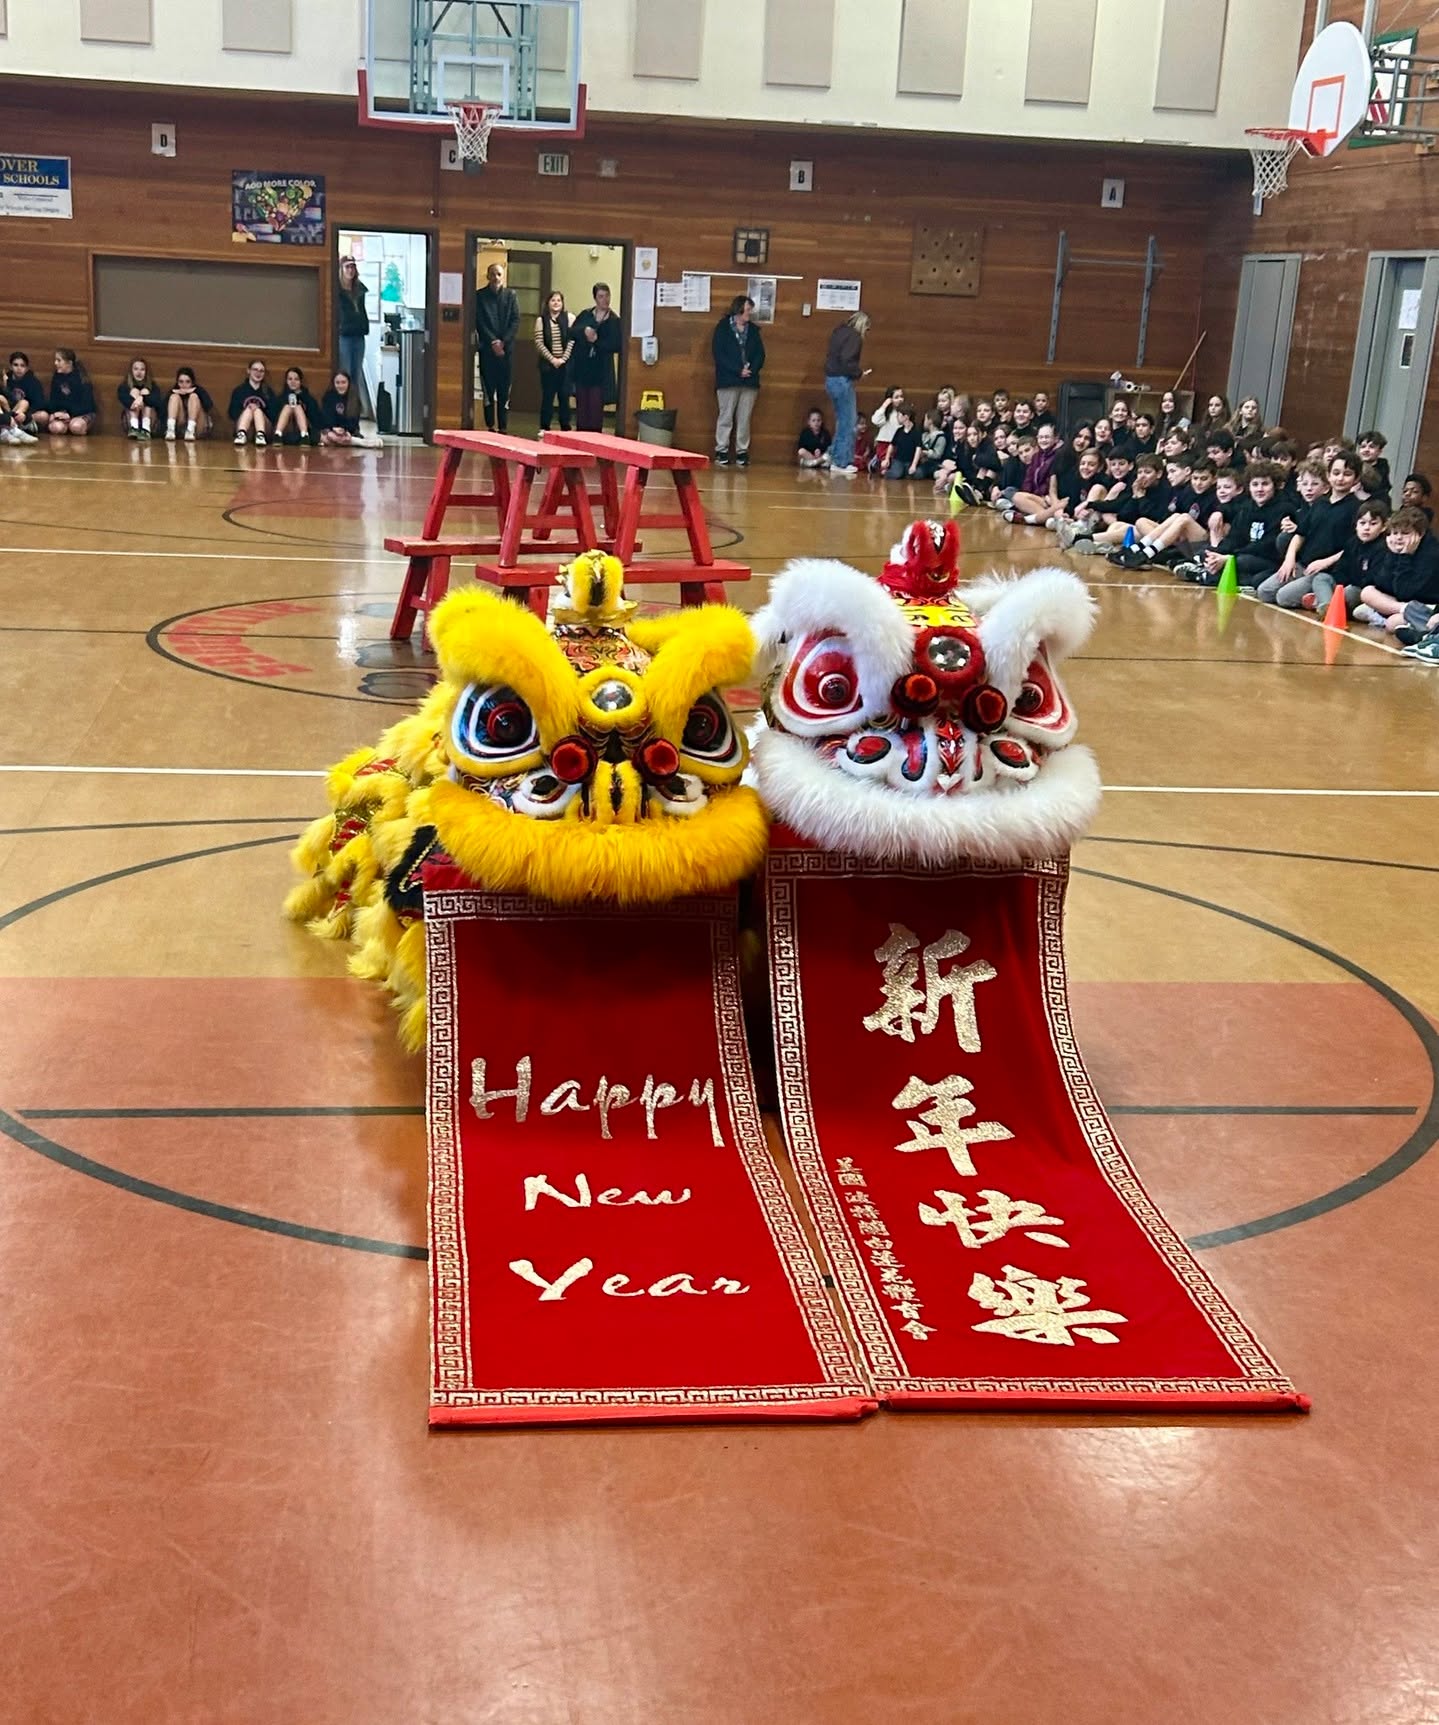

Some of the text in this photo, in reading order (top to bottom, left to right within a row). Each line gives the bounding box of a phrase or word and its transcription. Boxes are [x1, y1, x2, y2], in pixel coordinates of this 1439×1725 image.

[449, 150, 457, 164] C
[543, 155, 565, 173] EXIT
[3, 173, 60, 186] SCHOOLS
[245, 181, 262, 190] ADD
[263, 179, 287, 188] MORE
[798, 170, 806, 184] B
[1109, 186, 1117, 201] A
[469, 1055, 726, 1148] Happy
[863, 923, 1128, 1346] 新年快樂
[524, 1173, 692, 1211] New
[508, 1257, 751, 1301] Year
